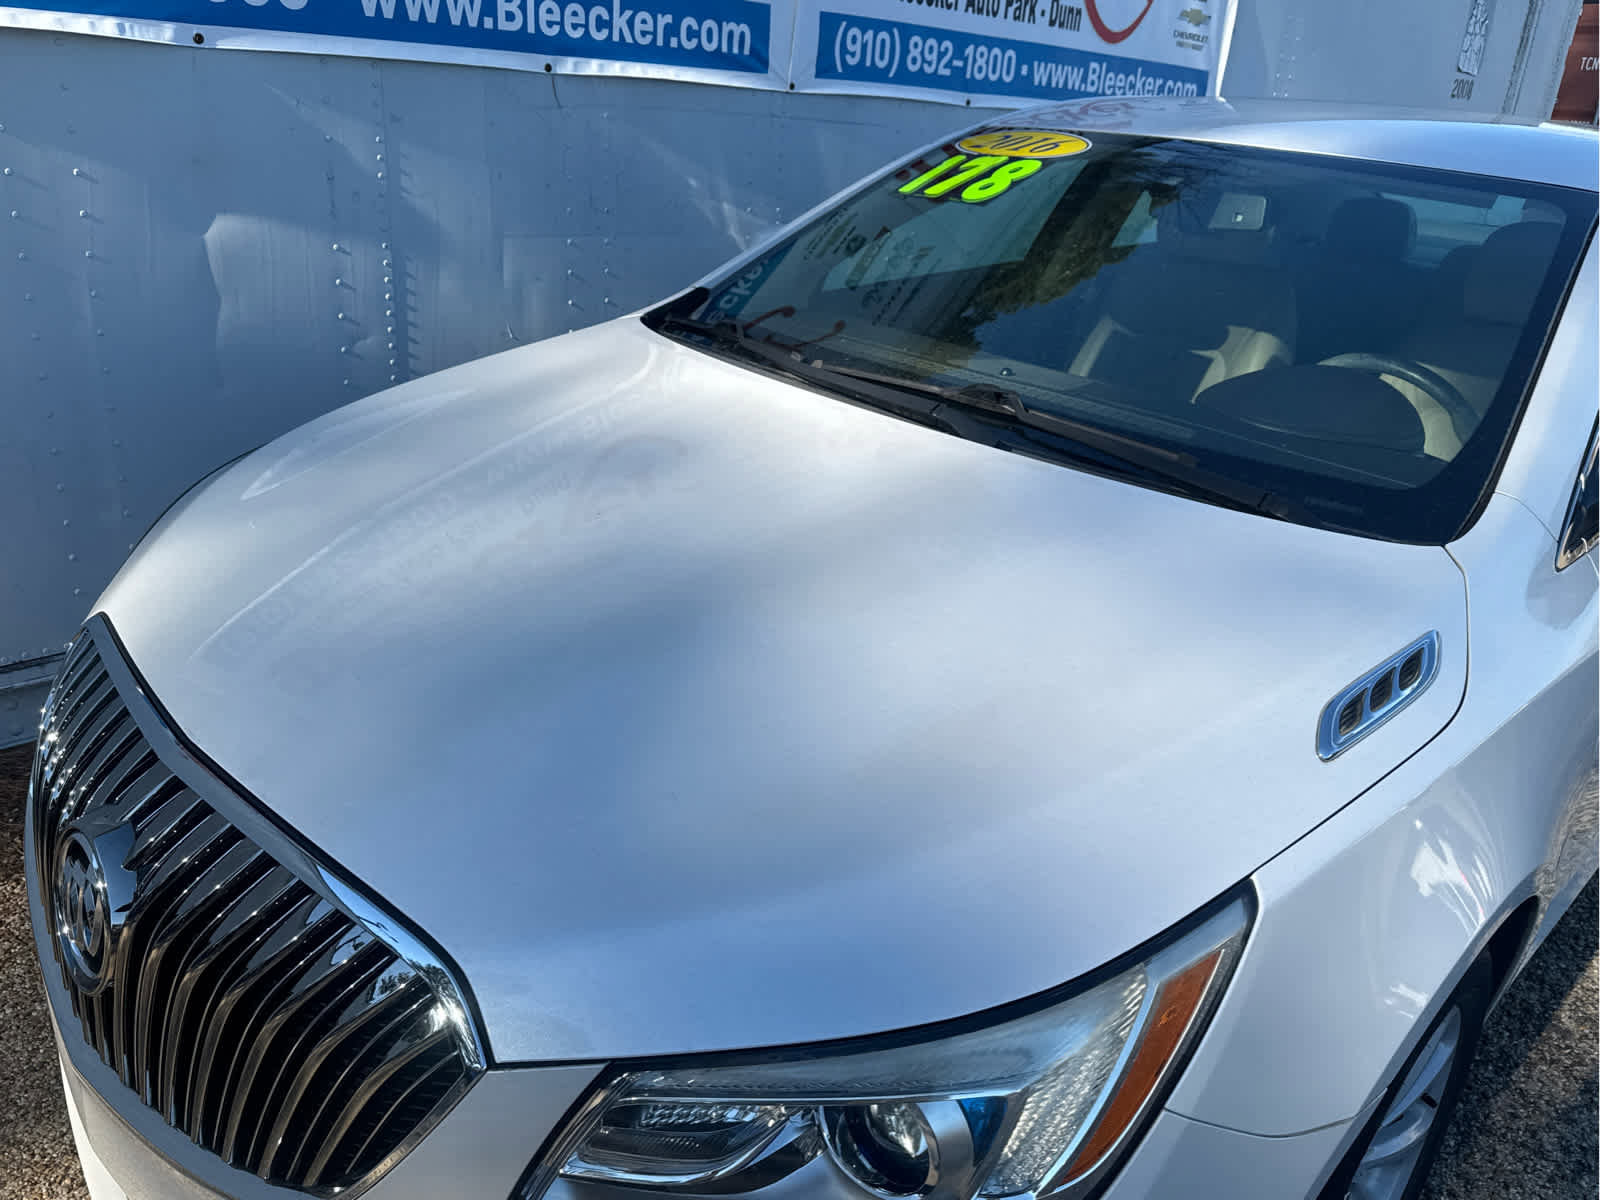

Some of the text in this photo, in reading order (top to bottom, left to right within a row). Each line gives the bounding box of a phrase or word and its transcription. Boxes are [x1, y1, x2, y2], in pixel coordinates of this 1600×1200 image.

[361, 0, 751, 56] www.Bleecker.com
[1003, 0, 1037, 25] Park
[1048, 0, 1082, 32] Dunn
[834, 20, 1198, 97] (910) 892-1800 www.Bleecker.com
[967, 134, 1078, 153] 2016
[898, 154, 1043, 203] 178
